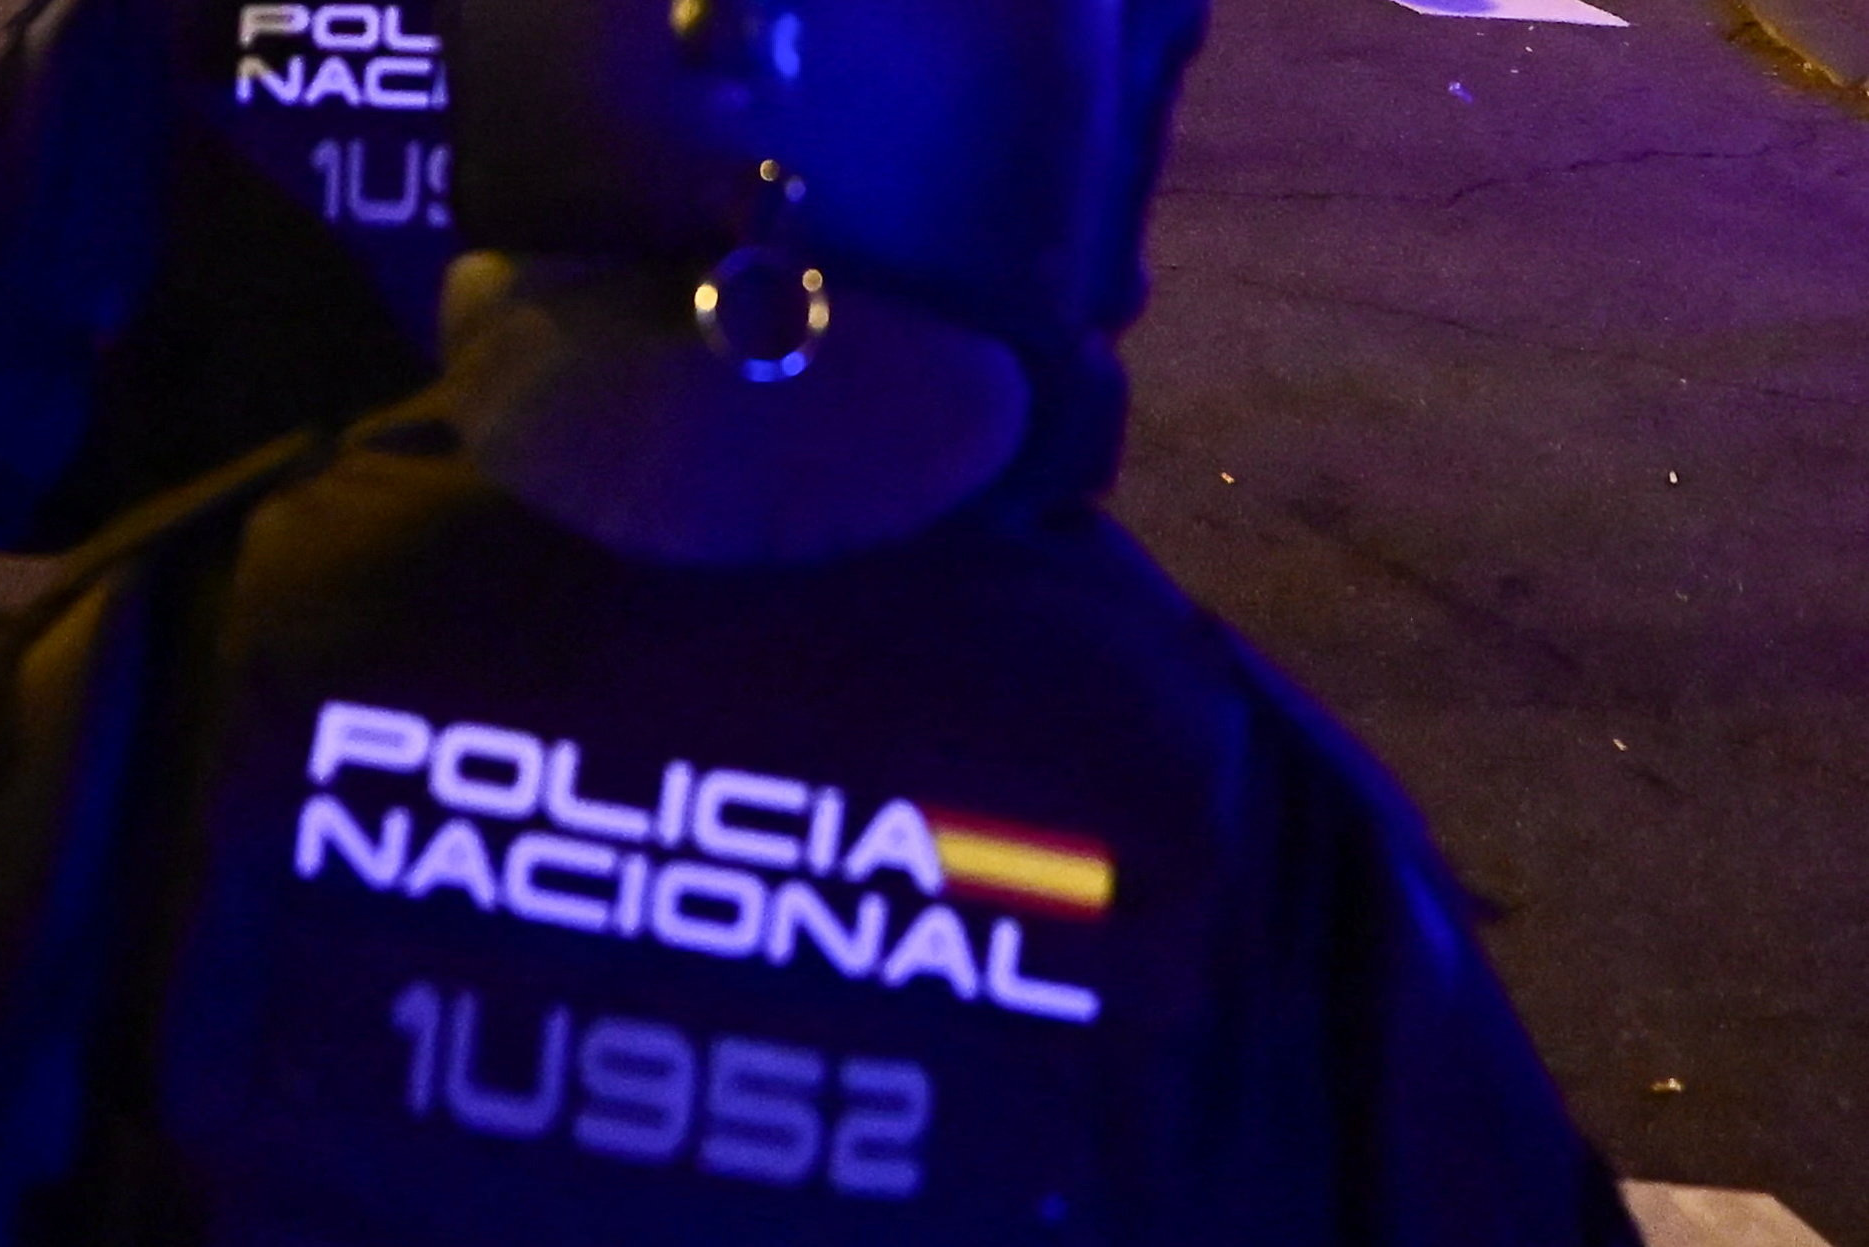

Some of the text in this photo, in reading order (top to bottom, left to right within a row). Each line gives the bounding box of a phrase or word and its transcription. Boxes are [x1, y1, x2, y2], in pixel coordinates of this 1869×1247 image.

[293, 792, 1102, 1023] NACIONAL
[307, 699, 946, 896] POLICIA
[390, 980, 933, 1200] 1U952
